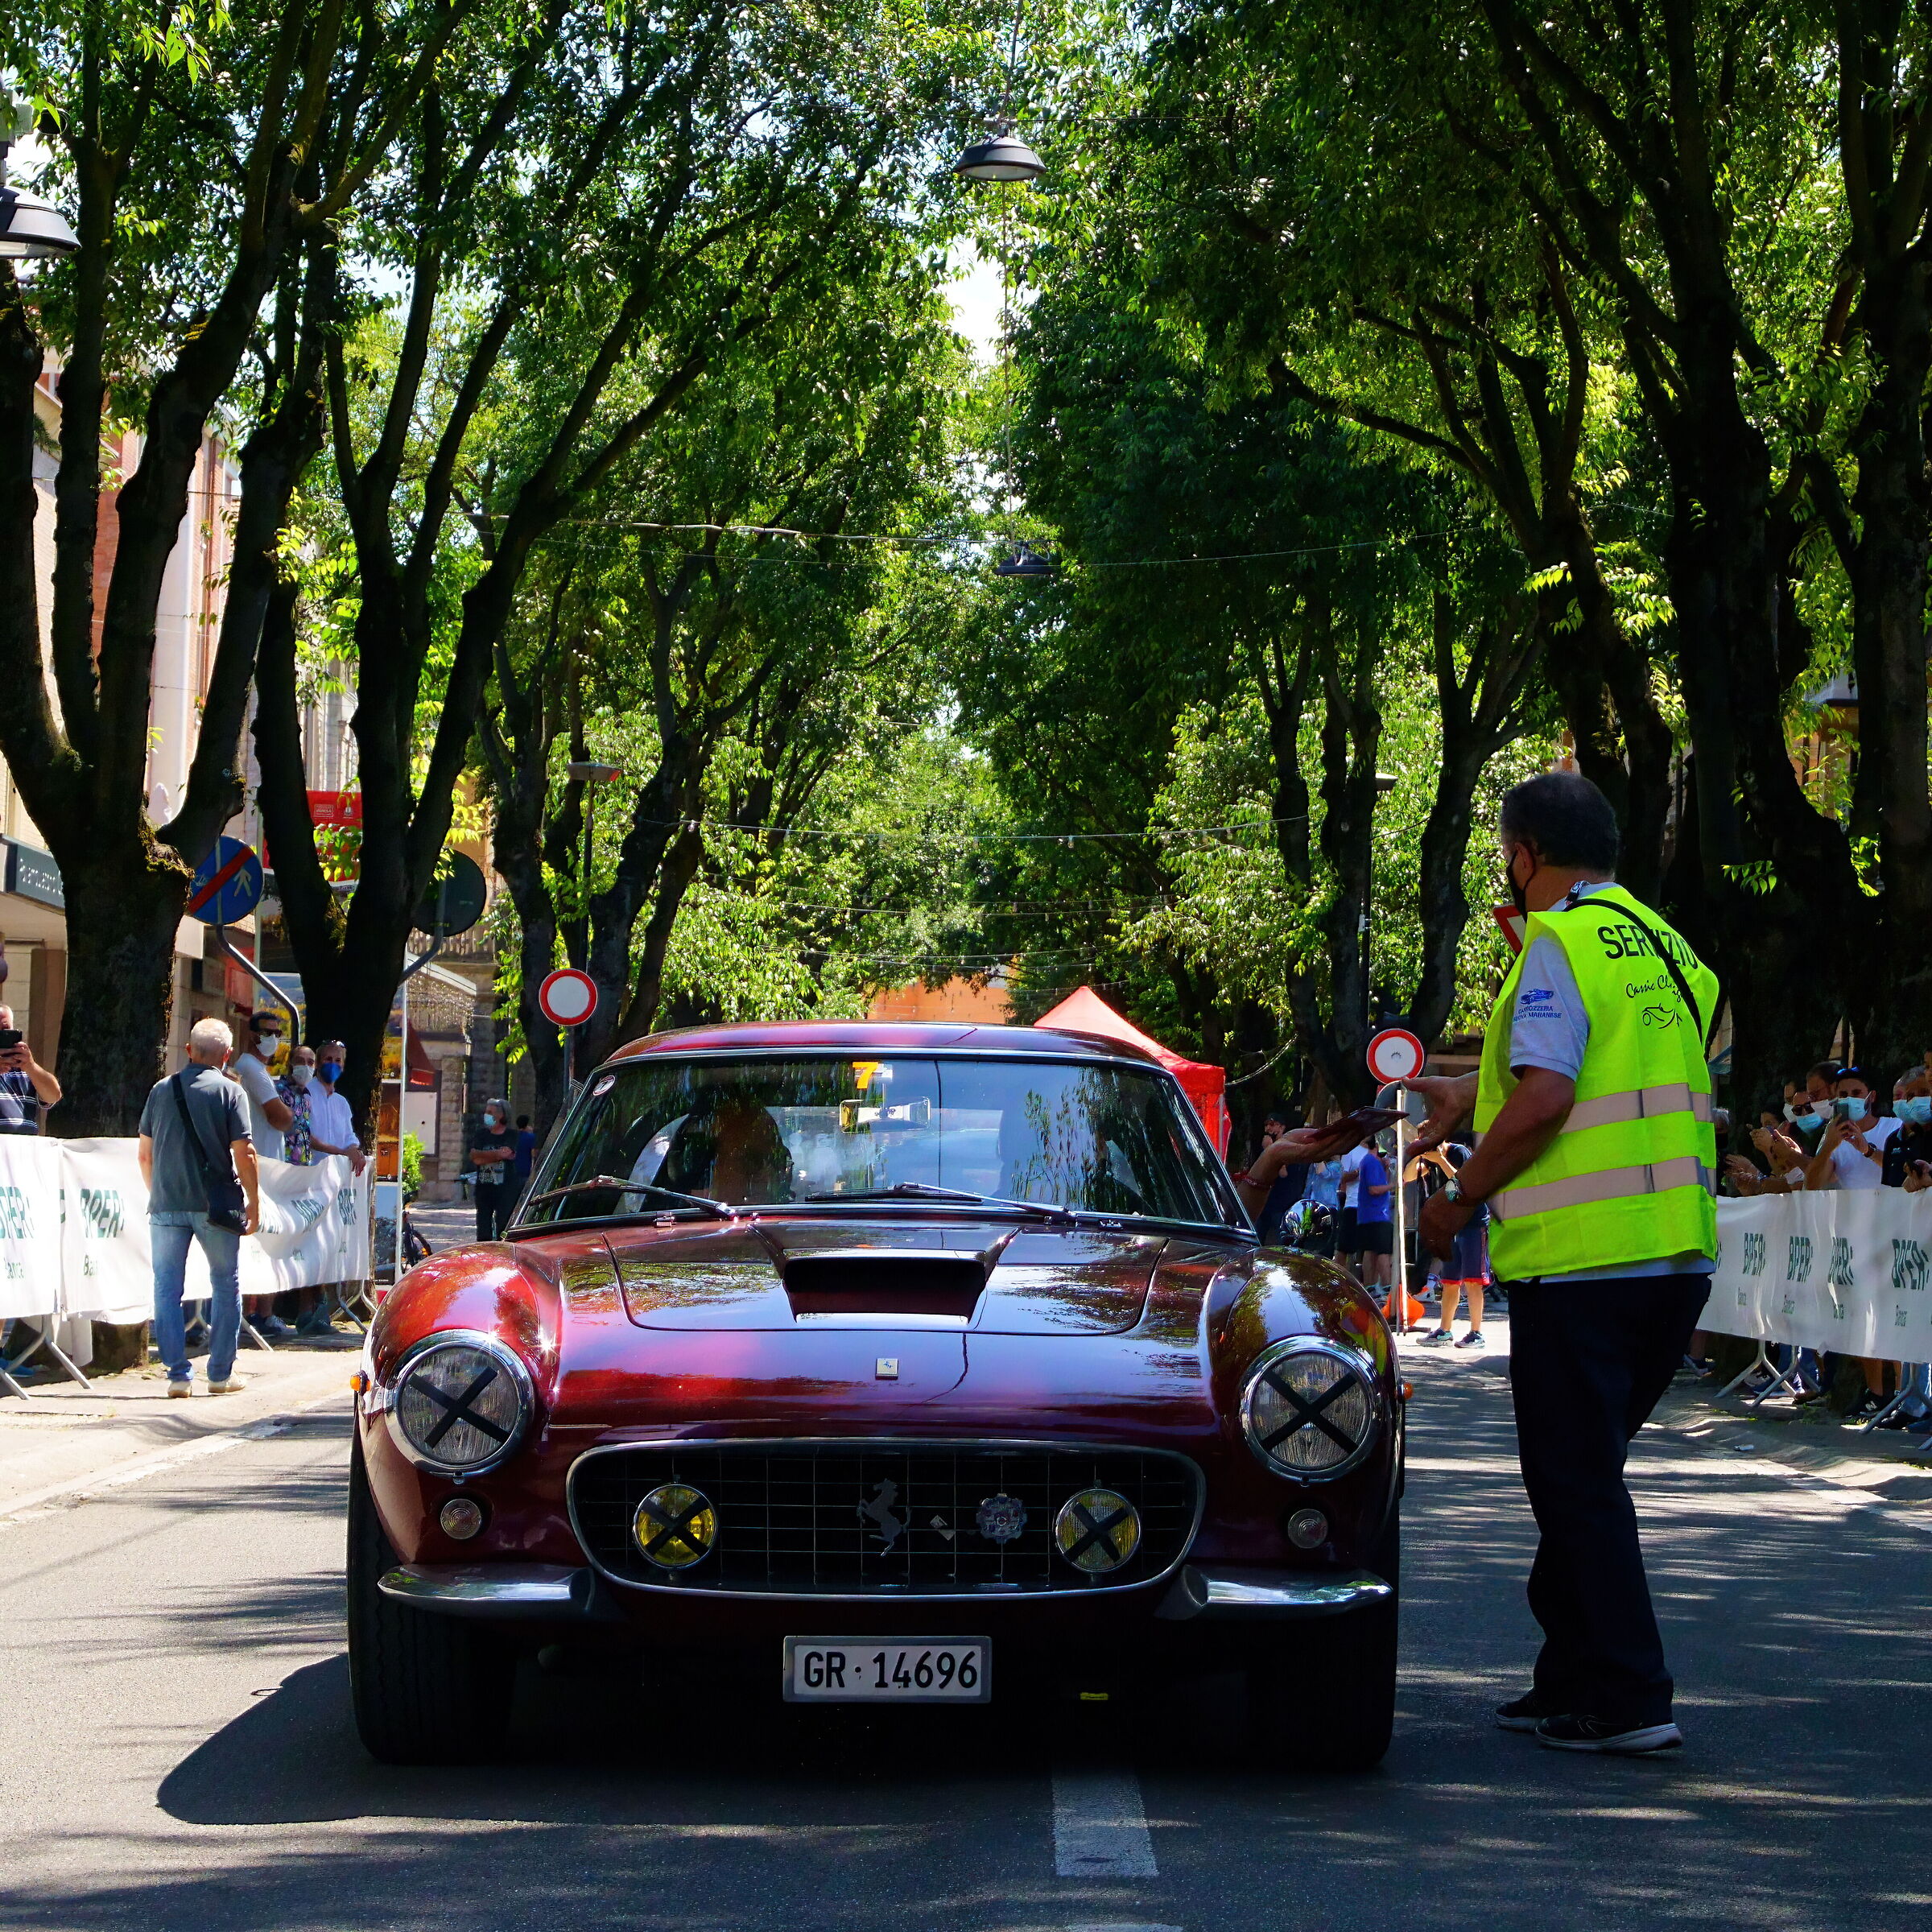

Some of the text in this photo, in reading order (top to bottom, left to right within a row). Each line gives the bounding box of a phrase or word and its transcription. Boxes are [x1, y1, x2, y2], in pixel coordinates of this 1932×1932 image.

[1597, 924, 1698, 969] SERZIO
[852, 1061, 879, 1089] 7
[873, 1650, 978, 1690] 14696
